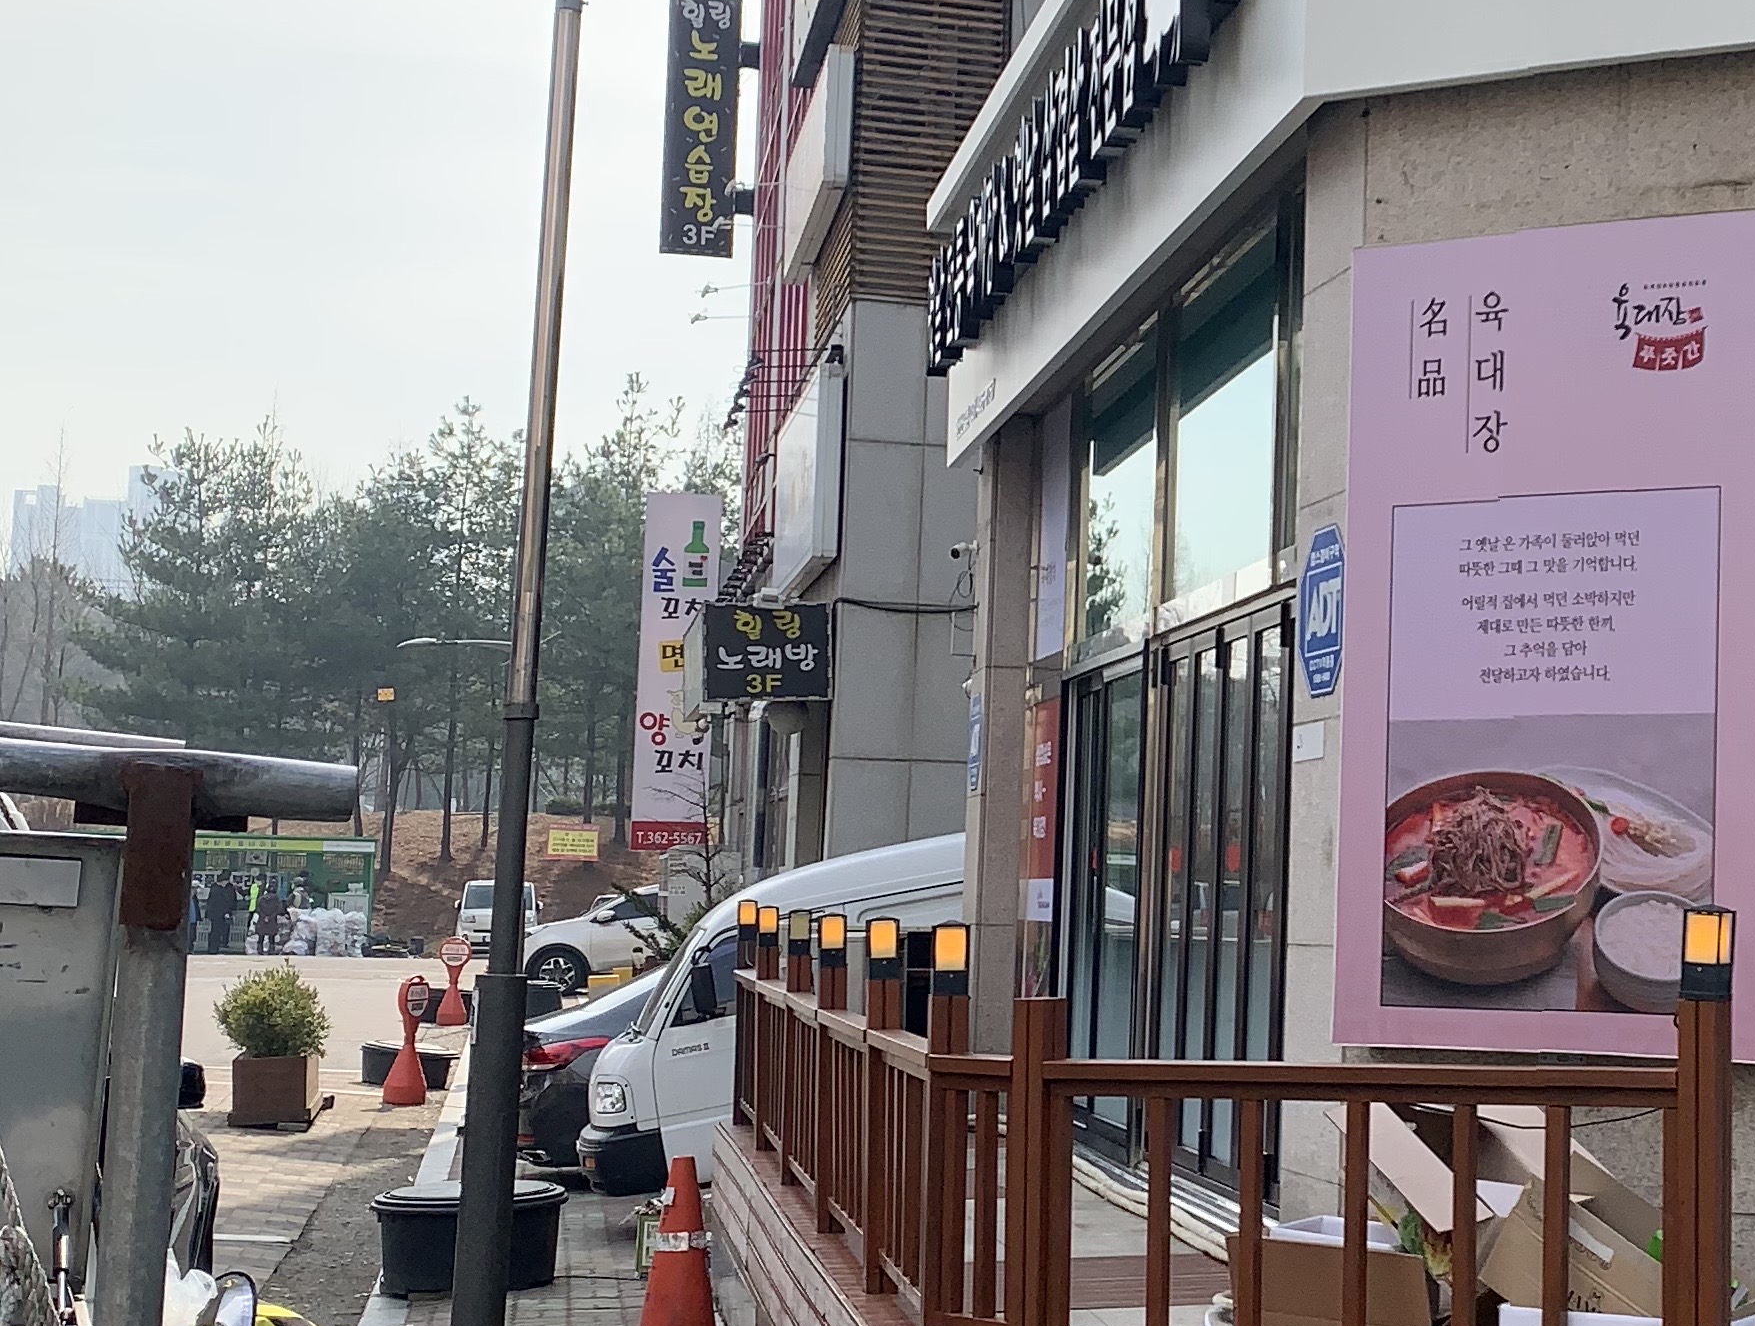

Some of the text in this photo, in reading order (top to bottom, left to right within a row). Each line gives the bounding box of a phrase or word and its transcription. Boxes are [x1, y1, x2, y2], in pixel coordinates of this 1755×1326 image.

[678, 29, 723, 224] 노래연습장
[681, 223, 718, 246] 3F
[1612, 282, 1687, 341] 육대장
[1415, 296, 1450, 399] 名品
[1471, 290, 1510, 455] 육대장
[1458, 538, 1473, 552] 그
[1475, 535, 1501, 553] 옛날
[1502, 535, 1516, 552] 온
[1518, 532, 1557, 551] 가족이
[1613, 529, 1641, 548] 먹던
[651, 545, 677, 594] 술
[1458, 554, 1639, 578] 따뜻한 그때 그 맛을 기억합니다.
[1305, 575, 1343, 643] ADT
[1461, 589, 1637, 612] 어릴적 집에서 먹던 소박하지만
[733, 609, 803, 641] 힐링
[1476, 618, 1515, 635] 제대로
[1516, 616, 1544, 634] 만든
[1545, 614, 1584, 633] 따뜻한
[716, 644, 821, 672] 노래방
[1503, 639, 1588, 658] 그 추억을 담아
[746, 673, 784, 694] 3F
[1478, 663, 1612, 685] 전달하고자 하였습니다.
[639, 711, 671, 747] 양
[654, 749, 704, 774] 꼬치
[636, 830, 703, 846] T.362-5567
